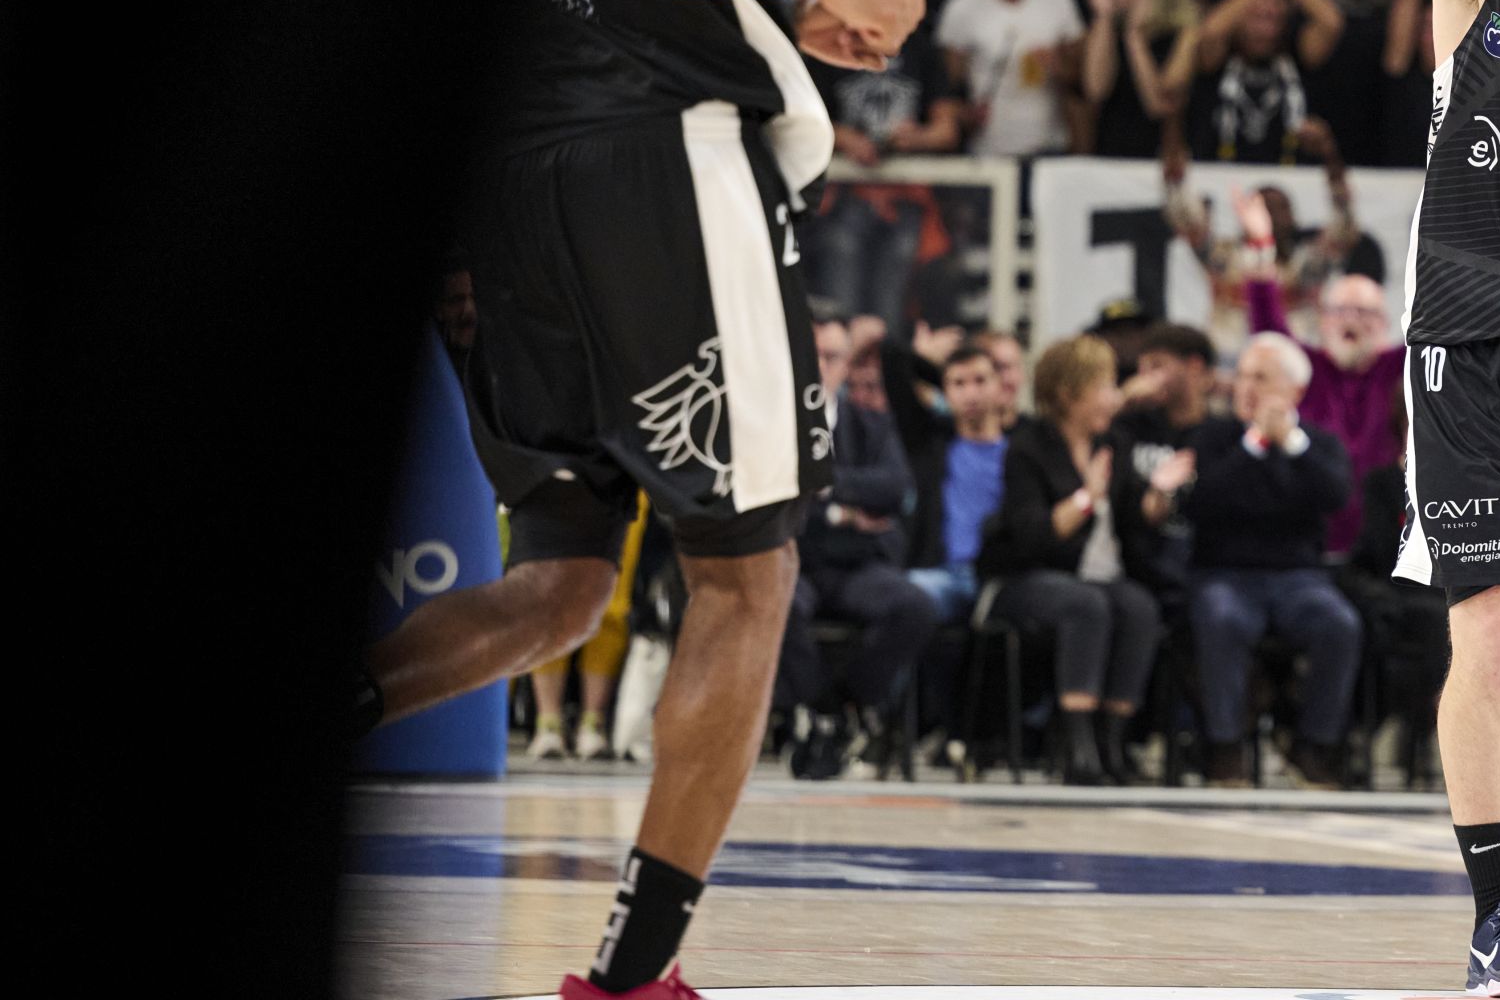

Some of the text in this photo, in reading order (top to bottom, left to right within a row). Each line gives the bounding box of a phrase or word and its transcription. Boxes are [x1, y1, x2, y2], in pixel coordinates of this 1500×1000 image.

[1420, 345, 1447, 392] 10
[1424, 497, 1500, 520] CAVIT
[1441, 521, 1478, 530] TRENTO
